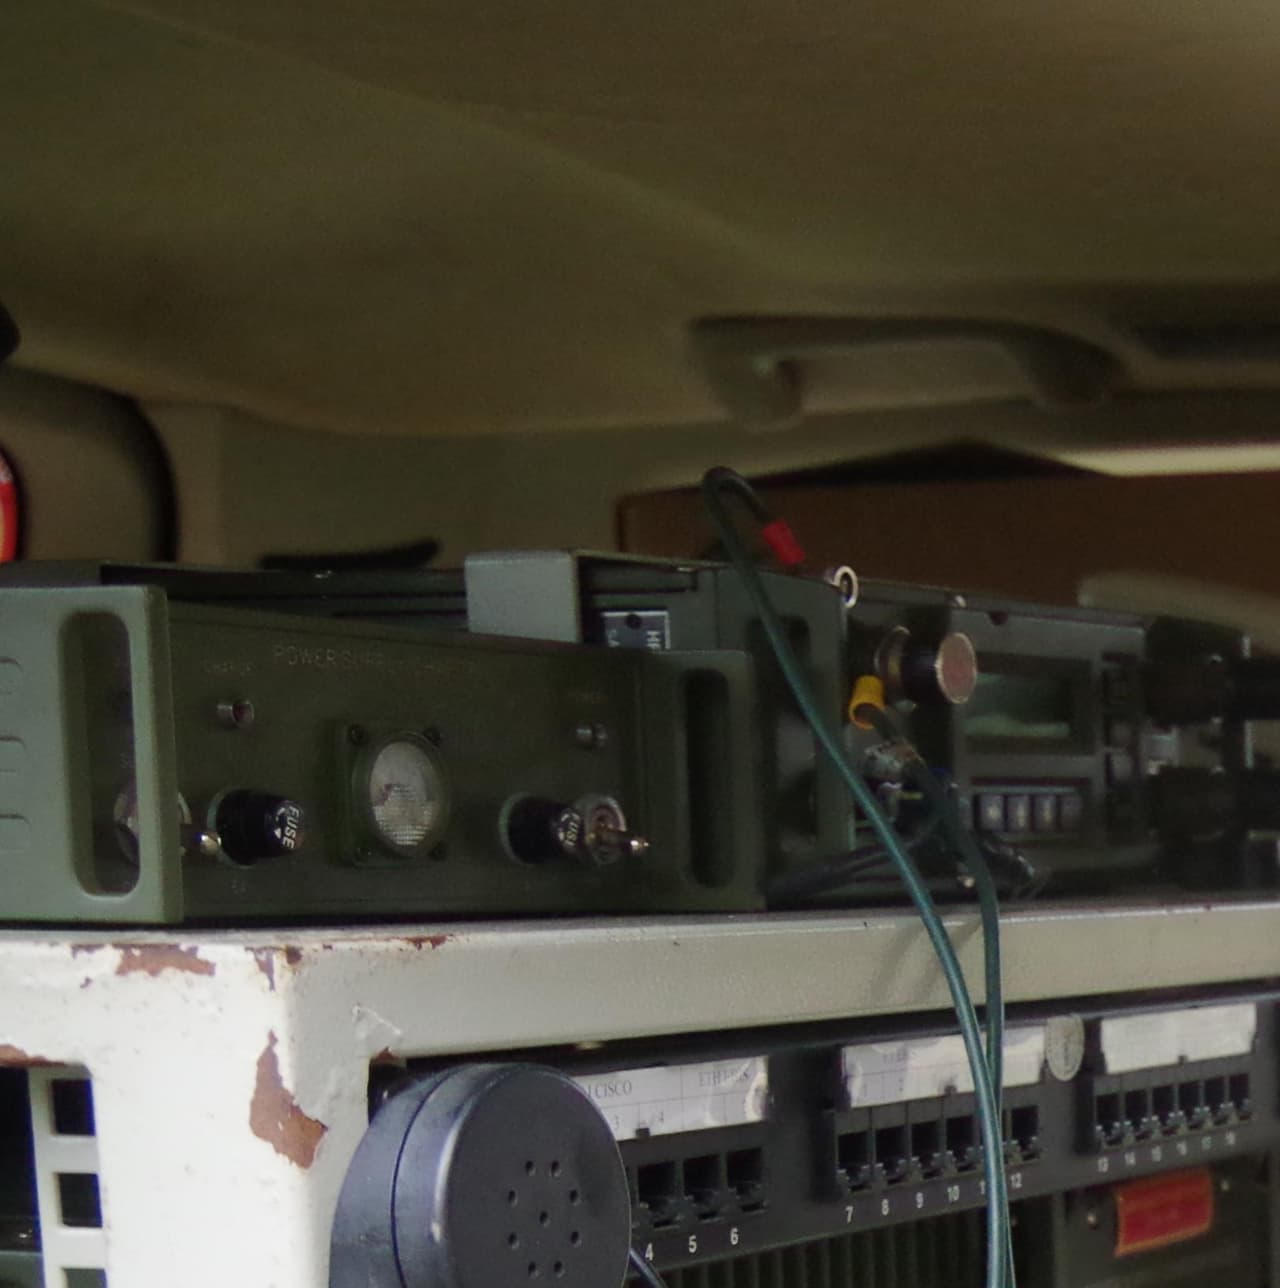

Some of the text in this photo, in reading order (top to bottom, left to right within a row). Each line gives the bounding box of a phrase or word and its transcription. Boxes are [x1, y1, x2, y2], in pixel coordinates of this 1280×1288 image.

[282, 805, 300, 849] FUSE
[595, 1080, 632, 1099] CISCO
[845, 1205, 854, 1223] 7
[881, 1198, 889, 1216] 8
[916, 1191, 924, 1208] 9
[947, 1185, 960, 1201] 10
[1010, 1172, 1022, 1189] 12
[645, 1227, 739, 1261] 4 5 6
